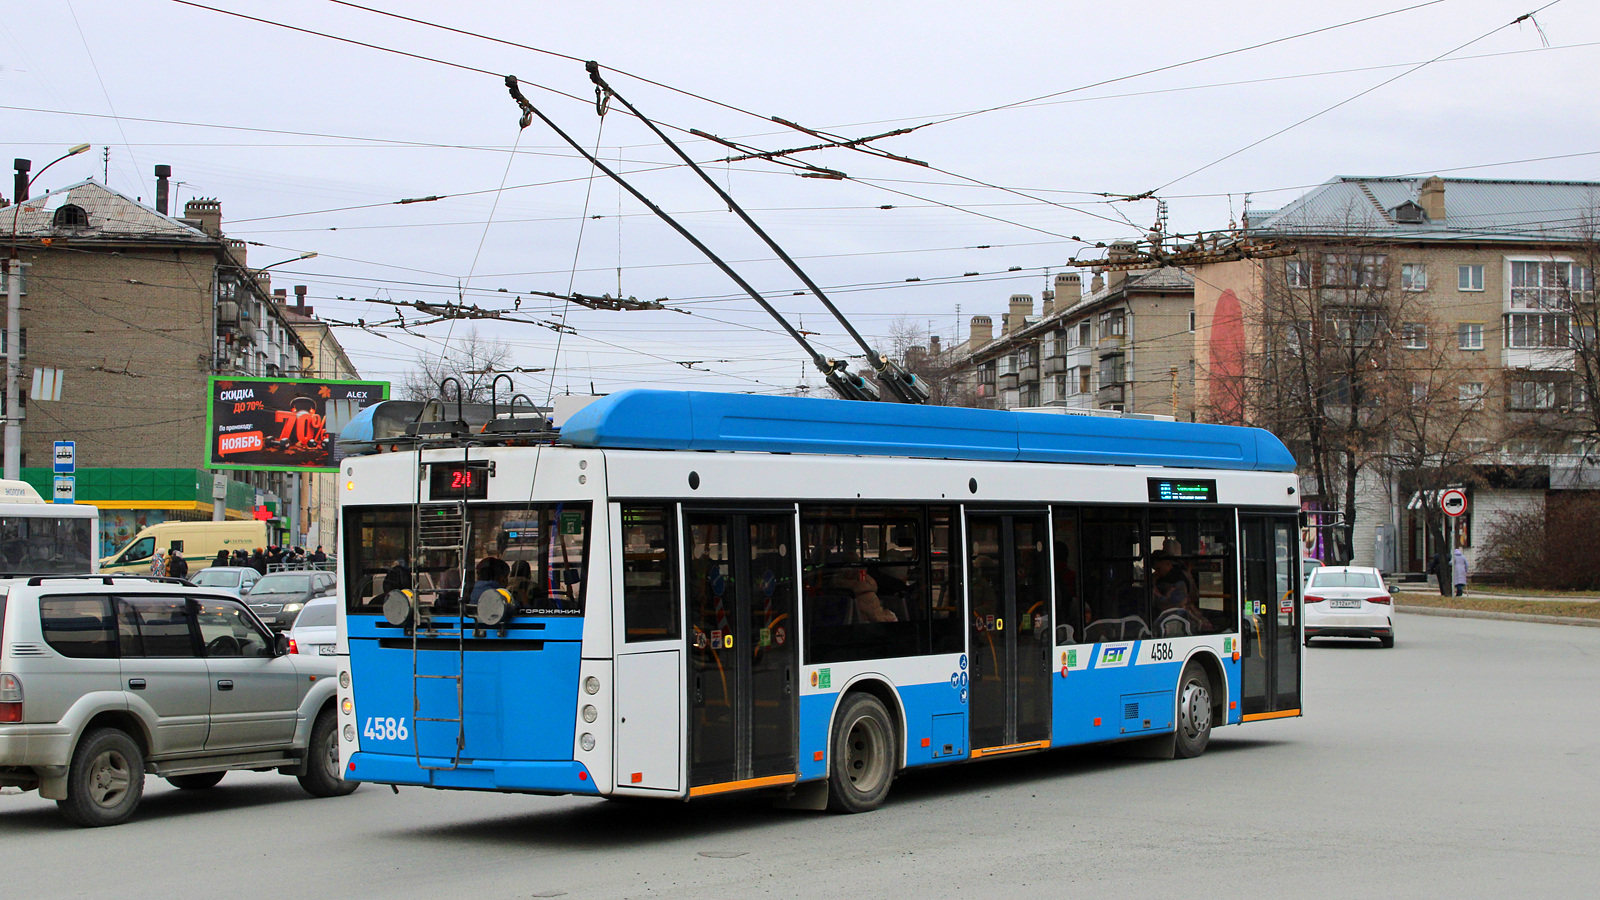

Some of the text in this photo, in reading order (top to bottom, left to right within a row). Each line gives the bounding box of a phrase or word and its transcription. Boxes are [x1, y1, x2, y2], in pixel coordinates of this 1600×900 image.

[220, 389, 254, 401] СКИДКА
[233, 401, 264, 414] ДО 70%
[275, 410, 329, 445] 70%
[222, 435, 261, 450] НОЯБРЬ
[451, 471, 472, 487] 24
[1150, 642, 1173, 661] 4586
[363, 717, 408, 740] 4586
